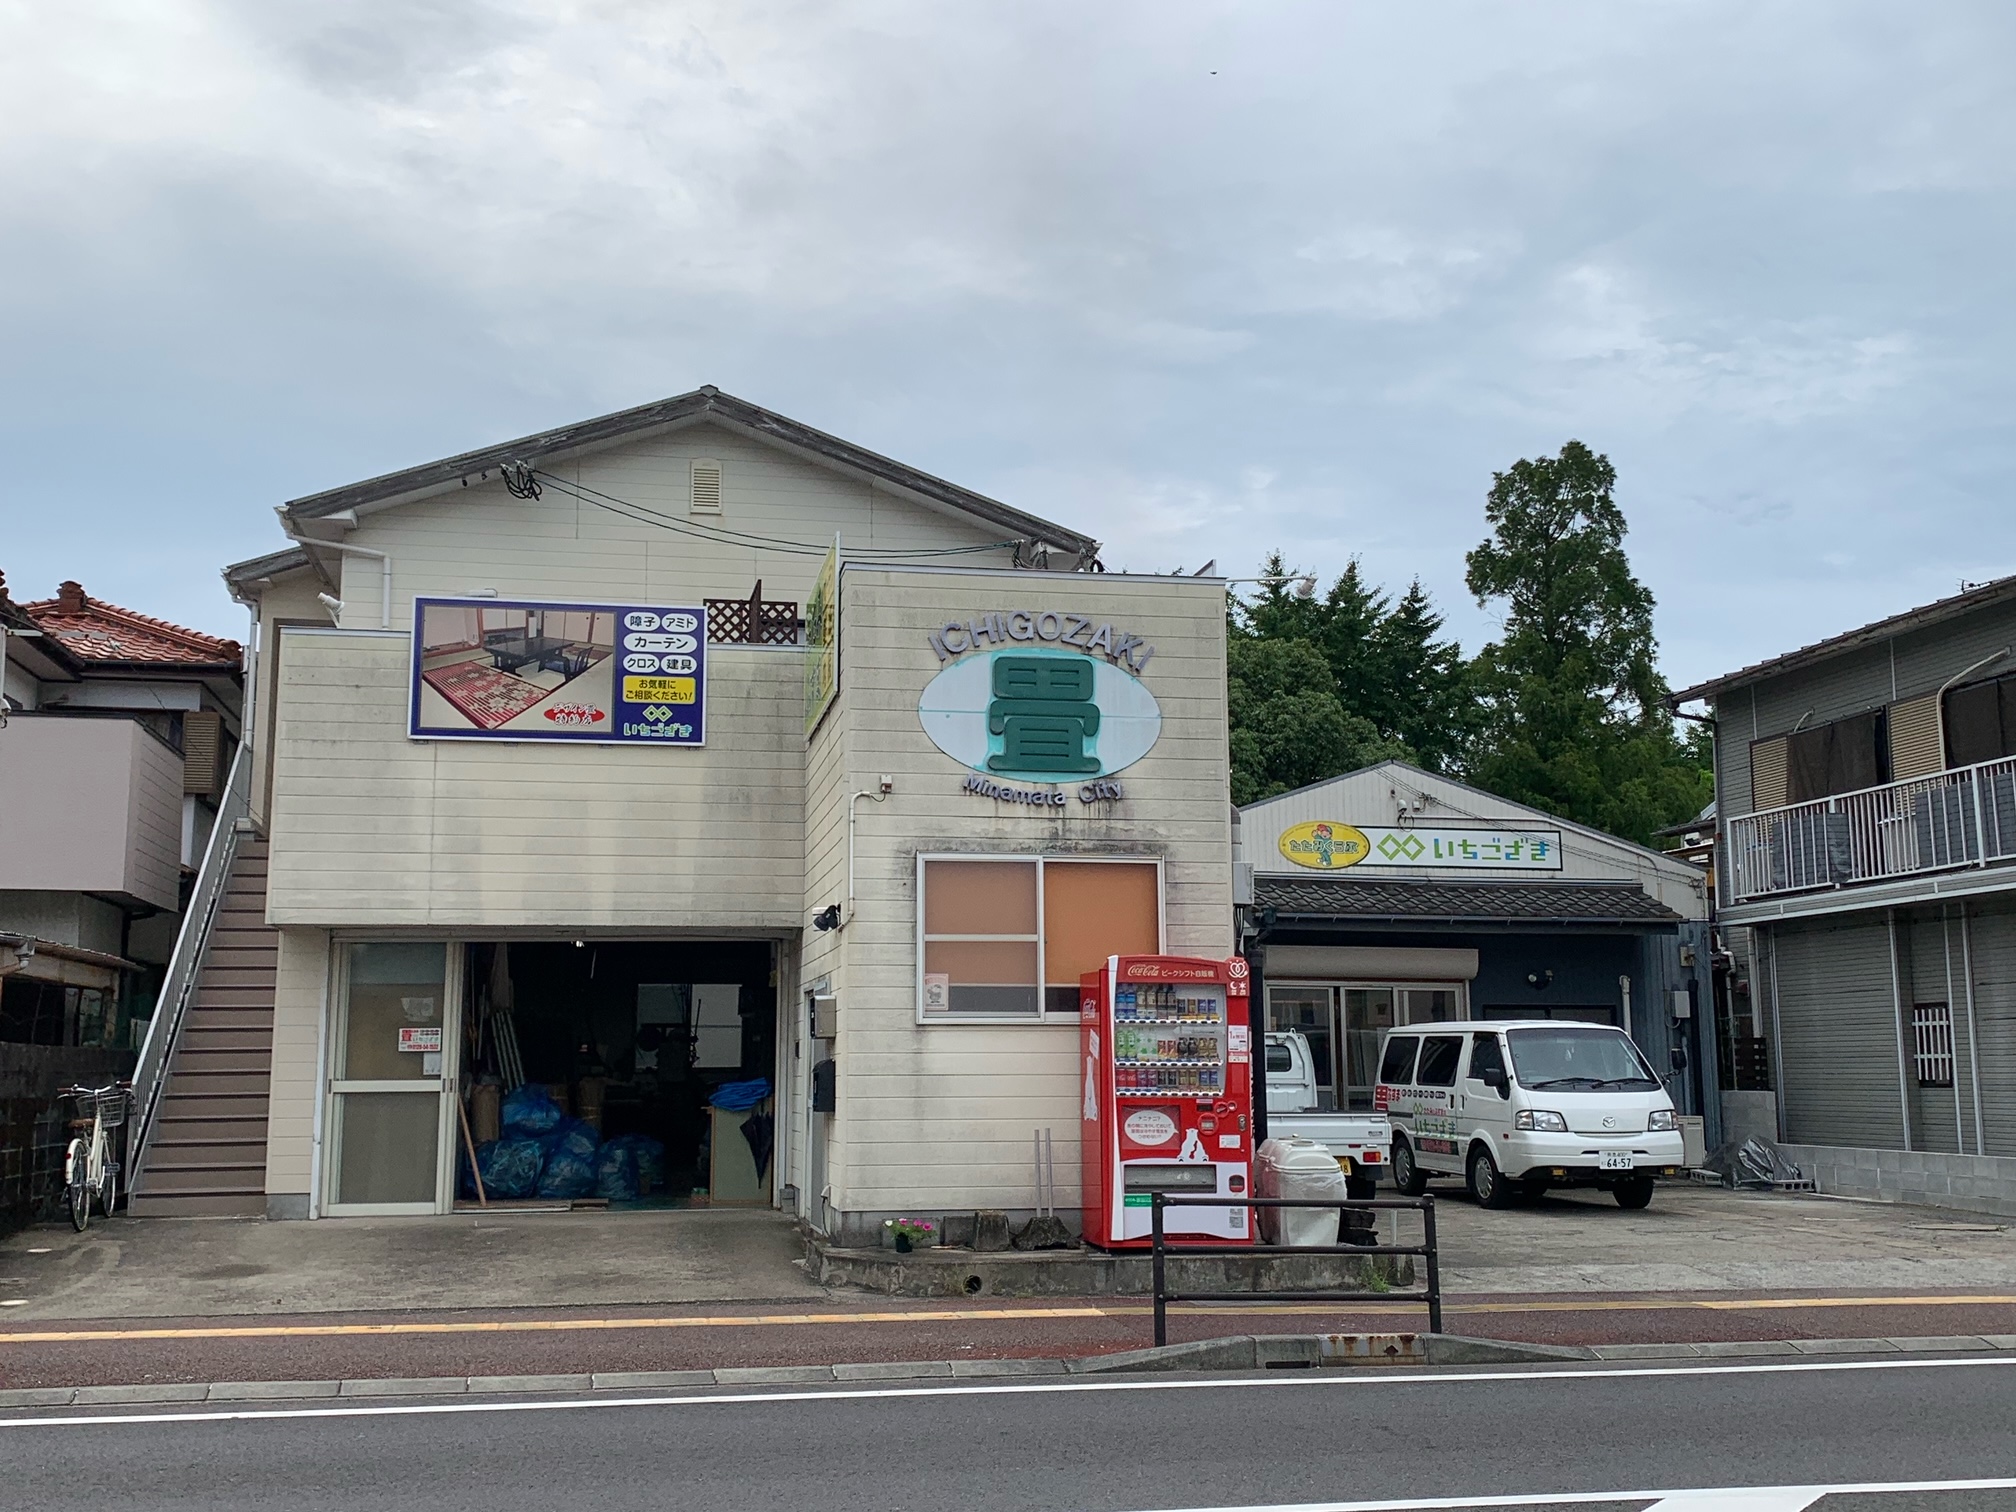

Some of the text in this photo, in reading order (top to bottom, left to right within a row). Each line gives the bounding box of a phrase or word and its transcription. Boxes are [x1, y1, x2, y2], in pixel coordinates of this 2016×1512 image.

[630, 615, 656, 627] 障子
[666, 617, 694, 629] アミド
[634, 636, 688, 649] カーテン
[928, 610, 1155, 673] ICHIGOZAKI
[627, 657, 657, 669] クロス
[666, 659, 693, 670] 建具
[638, 679, 676, 689] お気軽に
[623, 722, 693, 737] いちござき
[963, 772, 1123, 807] Minamata City
[1433, 836, 1551, 862] いちござき
[1606, 1157, 1631, 1168] 64-57
